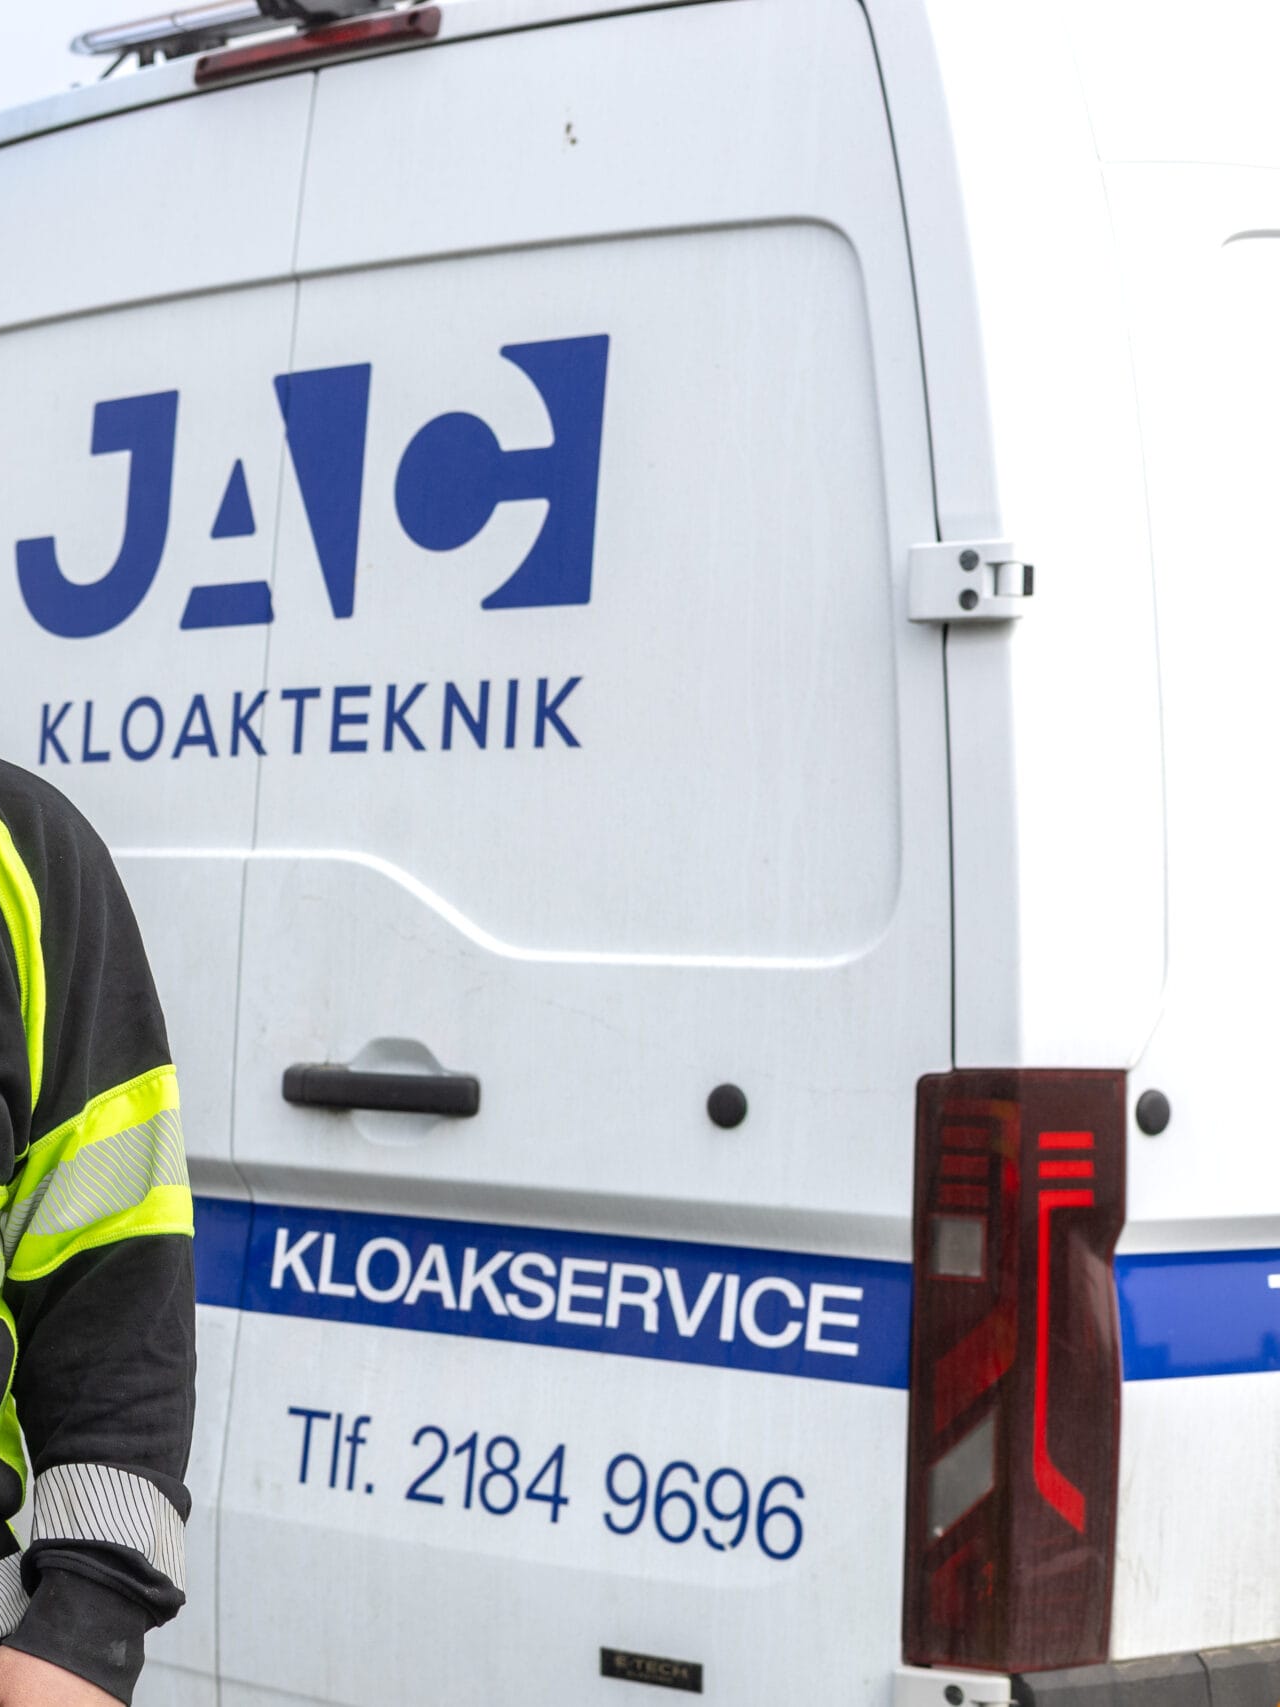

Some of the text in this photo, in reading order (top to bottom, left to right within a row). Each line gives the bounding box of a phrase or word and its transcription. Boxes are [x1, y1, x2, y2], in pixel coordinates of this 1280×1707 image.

[38, 676, 583, 766] KLOAKTEKNIK
[270, 1227, 864, 1357] KLOAKSERVICE
[287, 1406, 805, 1561] Tlf. 2184 9696
